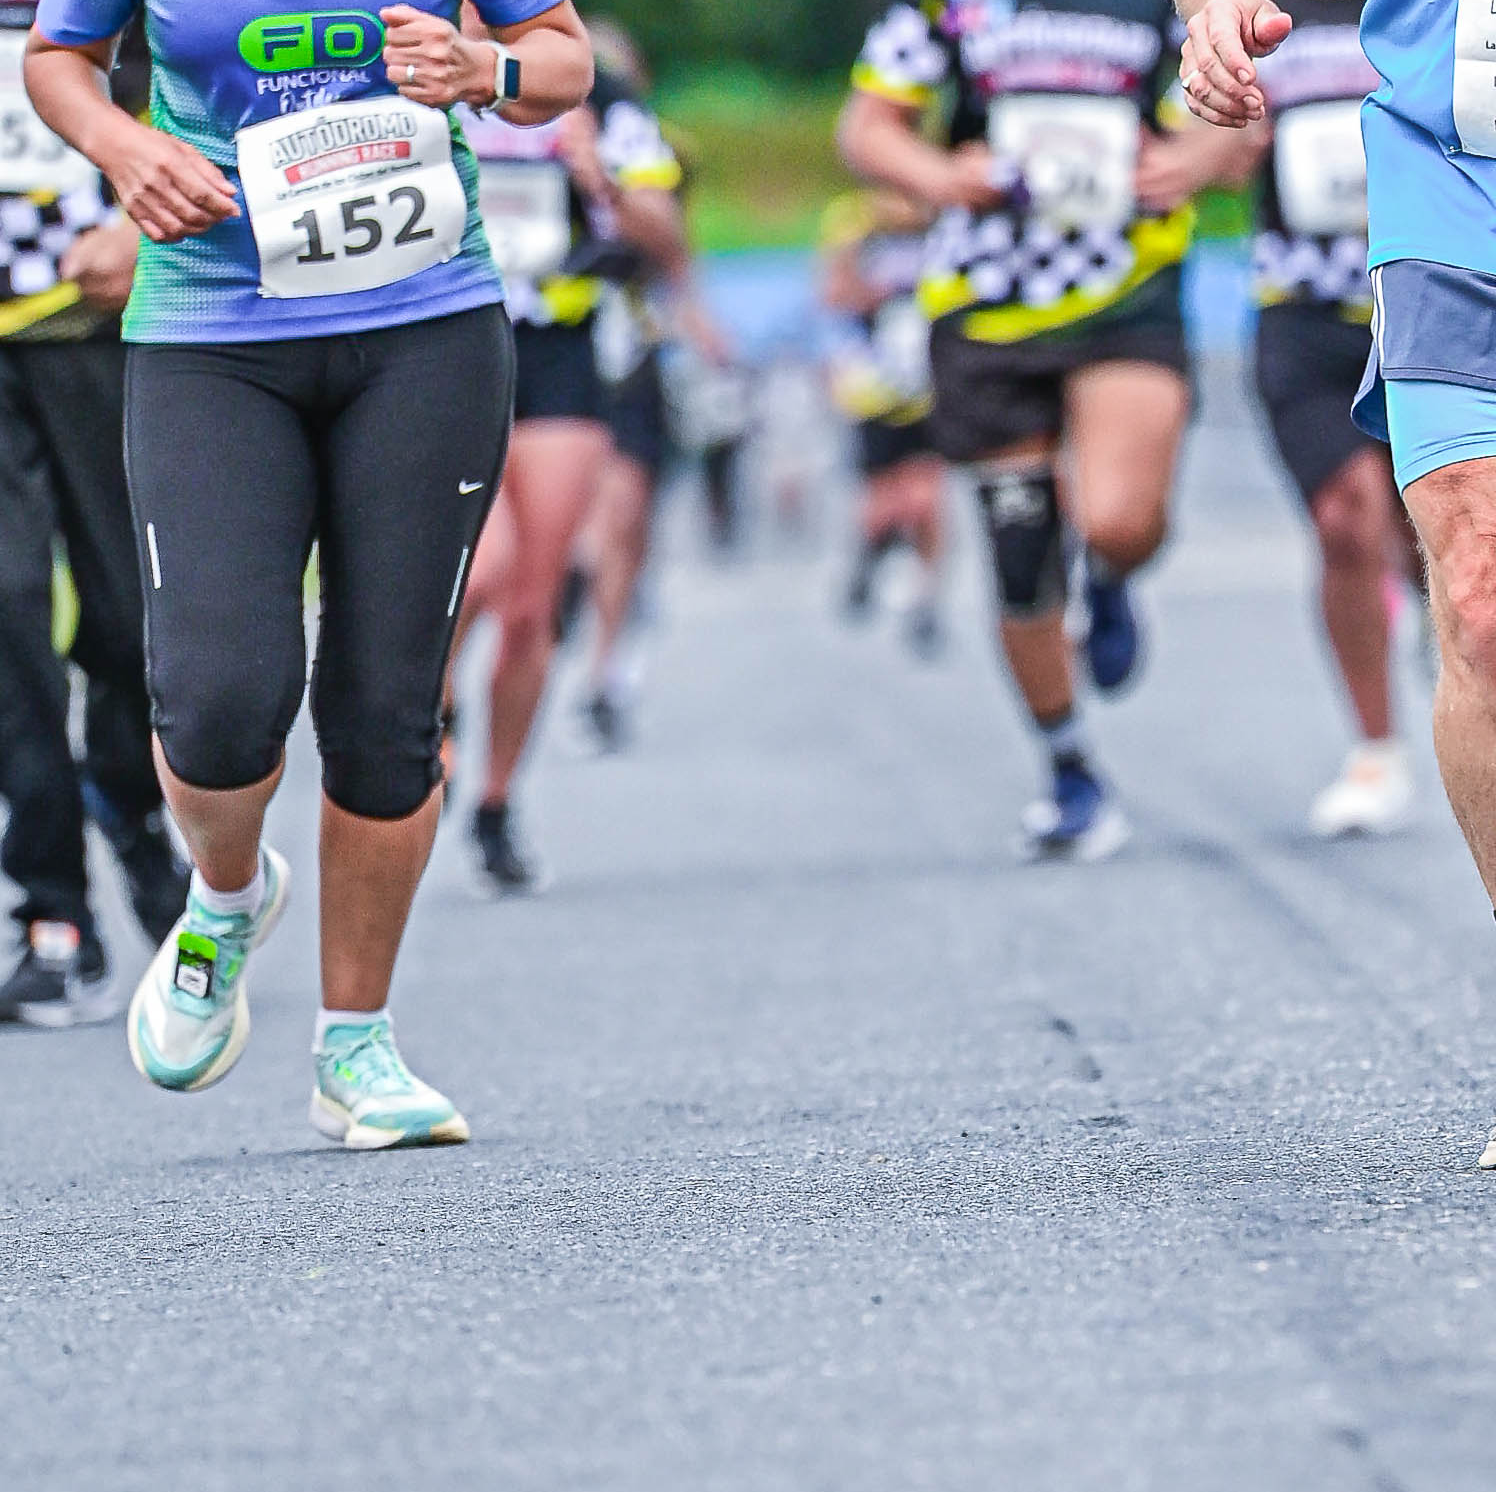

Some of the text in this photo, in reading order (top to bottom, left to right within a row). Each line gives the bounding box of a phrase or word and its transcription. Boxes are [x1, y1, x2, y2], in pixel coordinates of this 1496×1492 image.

[1486, 40, 1496, 50] La
[256, 69, 371, 95] FUNCIONAL
[292, 186, 434, 264] 152
